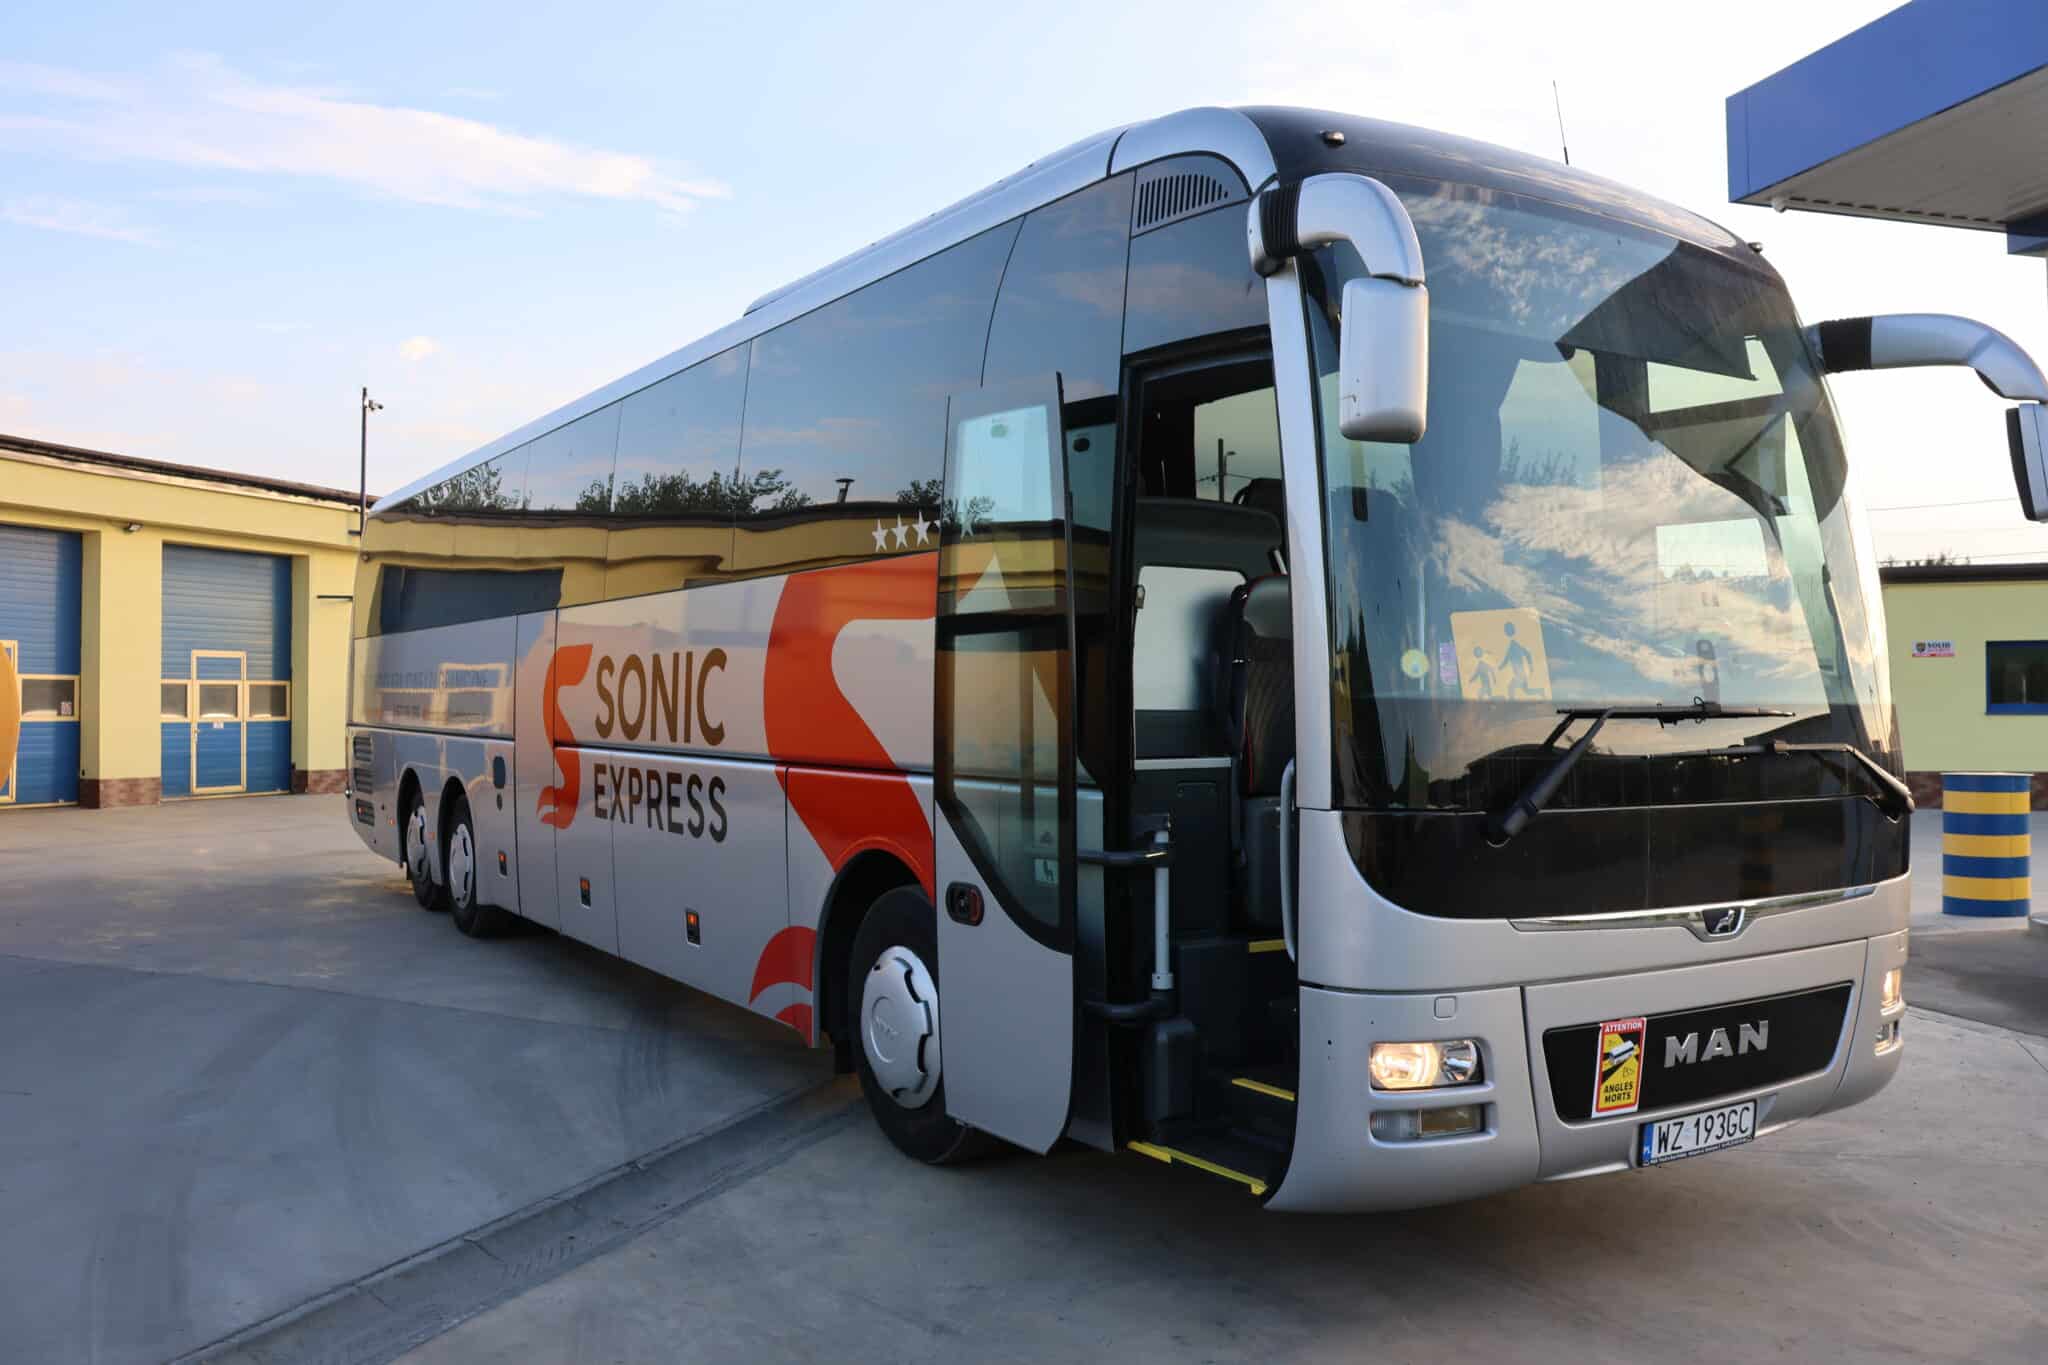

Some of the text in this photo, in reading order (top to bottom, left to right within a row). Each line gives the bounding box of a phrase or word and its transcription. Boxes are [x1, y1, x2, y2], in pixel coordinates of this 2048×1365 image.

[595, 647, 728, 746] SONIC
[593, 763, 728, 843] EXPRESS
[1604, 1021, 1643, 1033] ATTENTION
[1663, 1020, 1769, 1068] MAN
[1604, 1081, 1633, 1094] ANGLES
[1604, 1092, 1632, 1104] MORTS
[1657, 1121, 1685, 1154] WZ
[1694, 1106, 1750, 1146] 193GC
